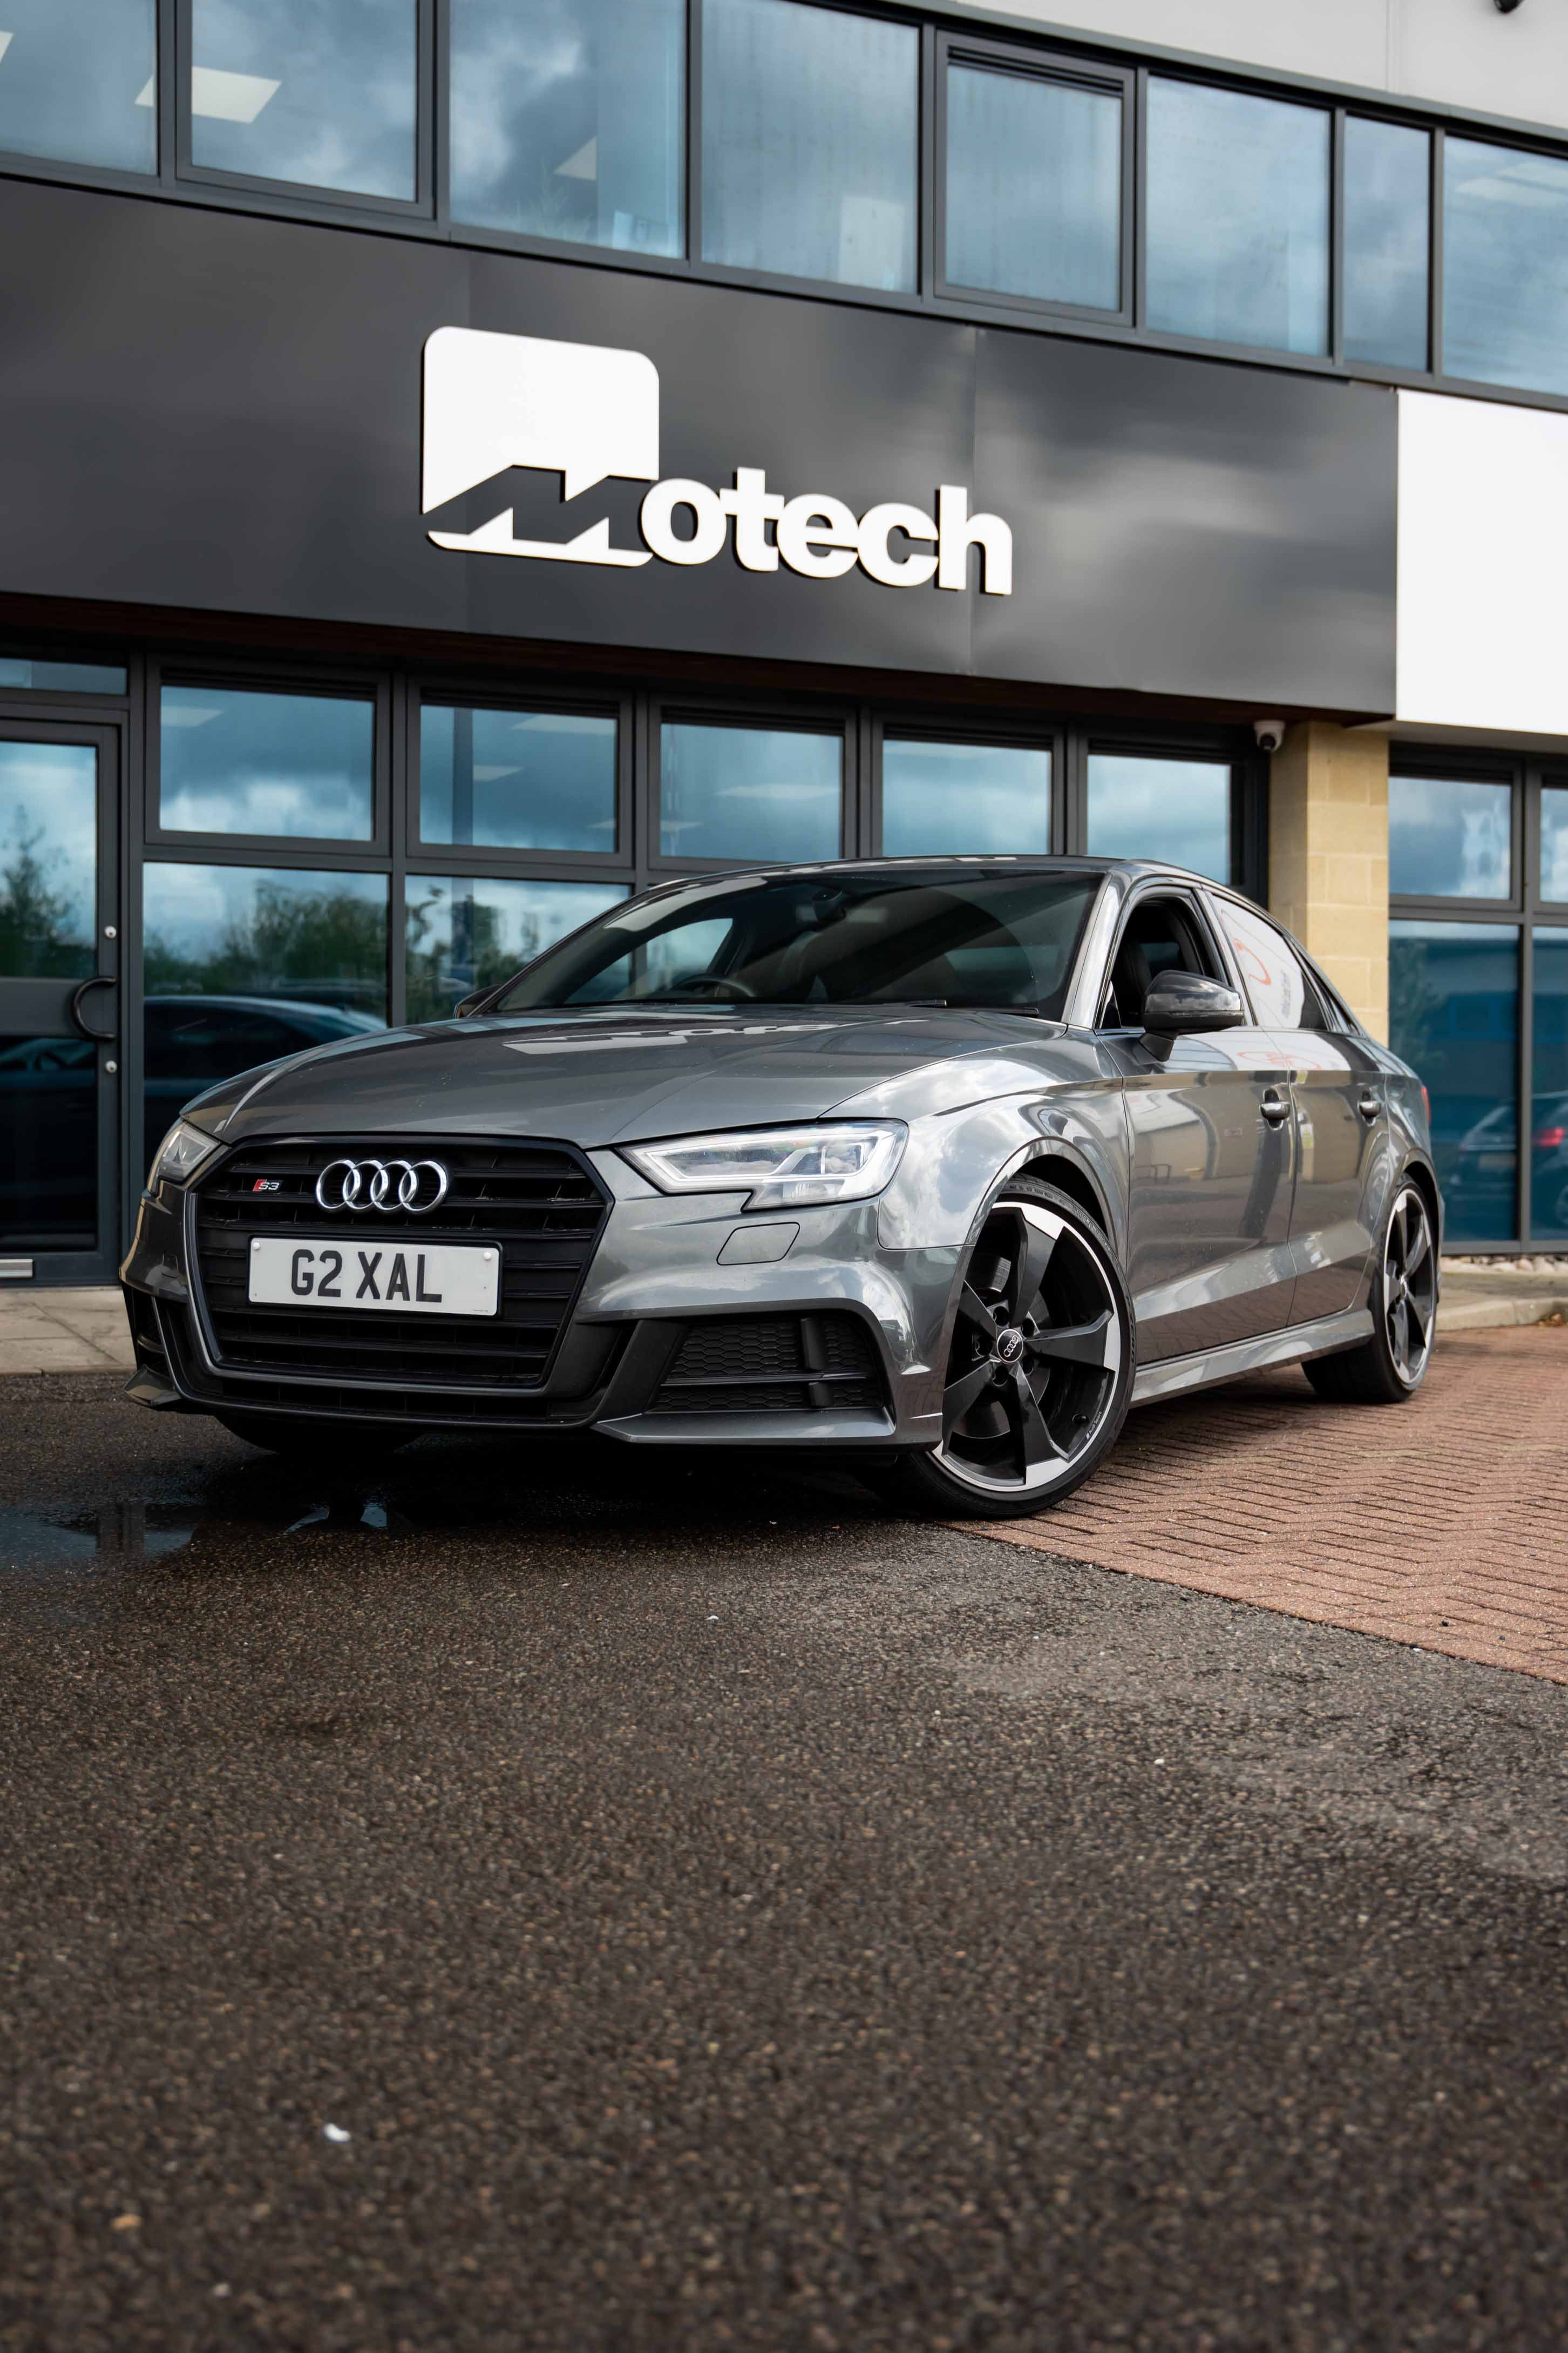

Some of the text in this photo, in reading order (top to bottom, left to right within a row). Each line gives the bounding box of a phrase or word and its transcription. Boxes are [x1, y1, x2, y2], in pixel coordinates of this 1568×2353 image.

[259, 1182, 280, 1191] S3
[291, 1249, 443, 1303] G2 XAL
